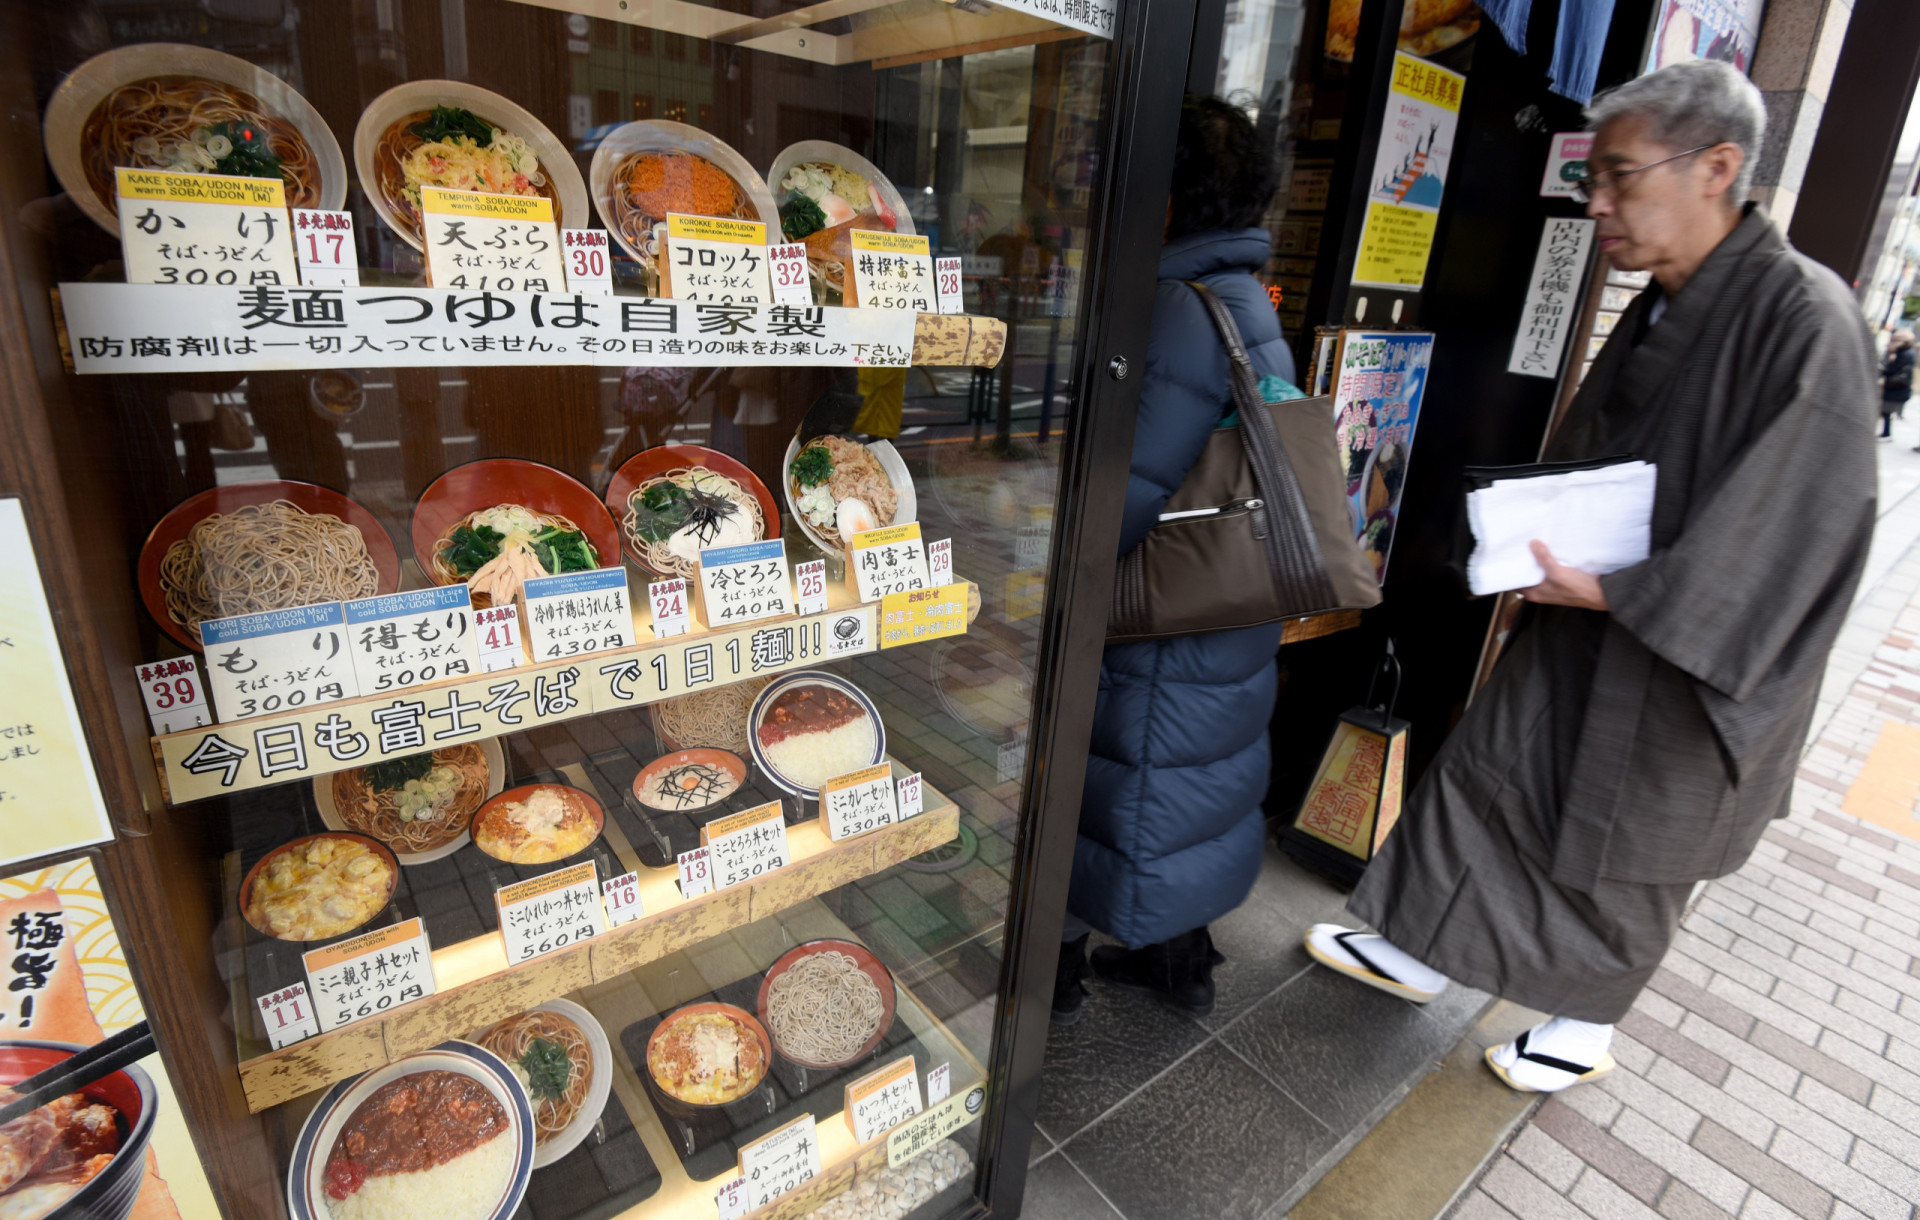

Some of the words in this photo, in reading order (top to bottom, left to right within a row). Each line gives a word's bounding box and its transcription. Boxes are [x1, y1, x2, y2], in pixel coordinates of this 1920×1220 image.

[1396, 62, 1460, 106] 正社員募集
[127, 174, 161, 185] KAKE
[165, 177, 241, 190] SOBA/UDON
[244, 182, 275, 193] Msize
[134, 186, 165, 195] warm
[170, 187, 245, 200] SOBA/UDON
[438, 192, 480, 203] TEMPURA
[486, 196, 538, 208] SOBA/UDON
[474, 204, 528, 215] SOBA/UDON
[134, 208, 278, 244] かけ
[437, 221, 549, 254] 天ぷら
[679, 218, 711, 228] KOROKKE
[716, 221, 756, 232] SOBA/UDON
[157, 244, 271, 262] そば・うどん
[306, 234, 344, 265] 17
[676, 246, 761, 273] コロッケ
[452, 254, 541, 271] そば・うどん
[574, 250, 604, 277] 30
[777, 261, 804, 287] 32
[859, 254, 927, 279] 特撰富士
[154, 267, 281, 286] 300円
[449, 275, 550, 292] 410円
[687, 273, 754, 289] そば・うどん
[869, 280, 922, 293] そば・うどん
[941, 273, 959, 295] 28
[237, 286, 826, 338] 麺つゆは自家製
[868, 296, 928, 311] 450円
[862, 545, 920, 571] 肉富士
[933, 552, 949, 573] 29
[710, 561, 783, 591] 冷とろろ
[801, 575, 823, 597] 25
[870, 566, 916, 583] そば・うどん
[721, 585, 777, 603] そば・うどん
[871, 577, 923, 598] 470円
[908, 590, 940, 603] お知らせ
[350, 599, 375, 611] MORI
[378, 590, 435, 607] SOBA/UDON
[358, 606, 377, 616] cold
[378, 597, 437, 614] SOBA/UDON
[656, 595, 684, 619] 24
[720, 598, 784, 620] 440円
[884, 600, 964, 626] 肉富士・冷肉富士
[209, 620, 237, 631] MORI
[240, 609, 305, 626] SOBA/UDON
[307, 606, 334, 617] Msize
[218, 628, 239, 638] cold
[241, 617, 307, 633] SOBA/UDON
[547, 619, 616, 639] そば・うどん
[360, 612, 467, 653] 得もり
[484, 625, 514, 650] 41
[546, 633, 624, 657] 430円
[217, 631, 340, 674] もり
[375, 642, 460, 668] そば・うどん
[234, 665, 332, 694] そば・うどん
[375, 658, 470, 690] 500円
[152, 677, 196, 710] 39
[236, 682, 344, 718] 300円
[833, 780, 890, 813] ミニカレーセット
[903, 784, 919, 805] 12
[841, 801, 887, 822] そば・うどん
[840, 812, 892, 837] 530円
[716, 824, 781, 858] ミニとろろ丼セット
[727, 844, 778, 869] そば・うどん
[685, 861, 707, 883] 13
[725, 856, 783, 886] 530円
[508, 885, 594, 928] ミニひれかつ丼セット
[611, 886, 637, 909] 16
[521, 911, 589, 940] そば・うどん
[342, 936, 386, 955] SOBA/UDON
[520, 924, 596, 960] 560円
[318, 945, 421, 995] ミニ親子丼セット
[336, 970, 416, 1006] そば・うどん
[272, 1000, 306, 1029] 11
[335, 984, 424, 1026] 560円
[934, 1076, 943, 1091] 7
[858, 1077, 914, 1117] かつ丼セット
[866, 1097, 909, 1125] そば・うどん
[866, 1106, 916, 1141] 720円
[893, 1104, 953, 1146] 当店のごはんは
[911, 1122, 938, 1144] 国産米
[751, 1137, 813, 1180] かつ丼
[728, 1190, 739, 1208] 5
[758, 1168, 814, 1206] 490円
